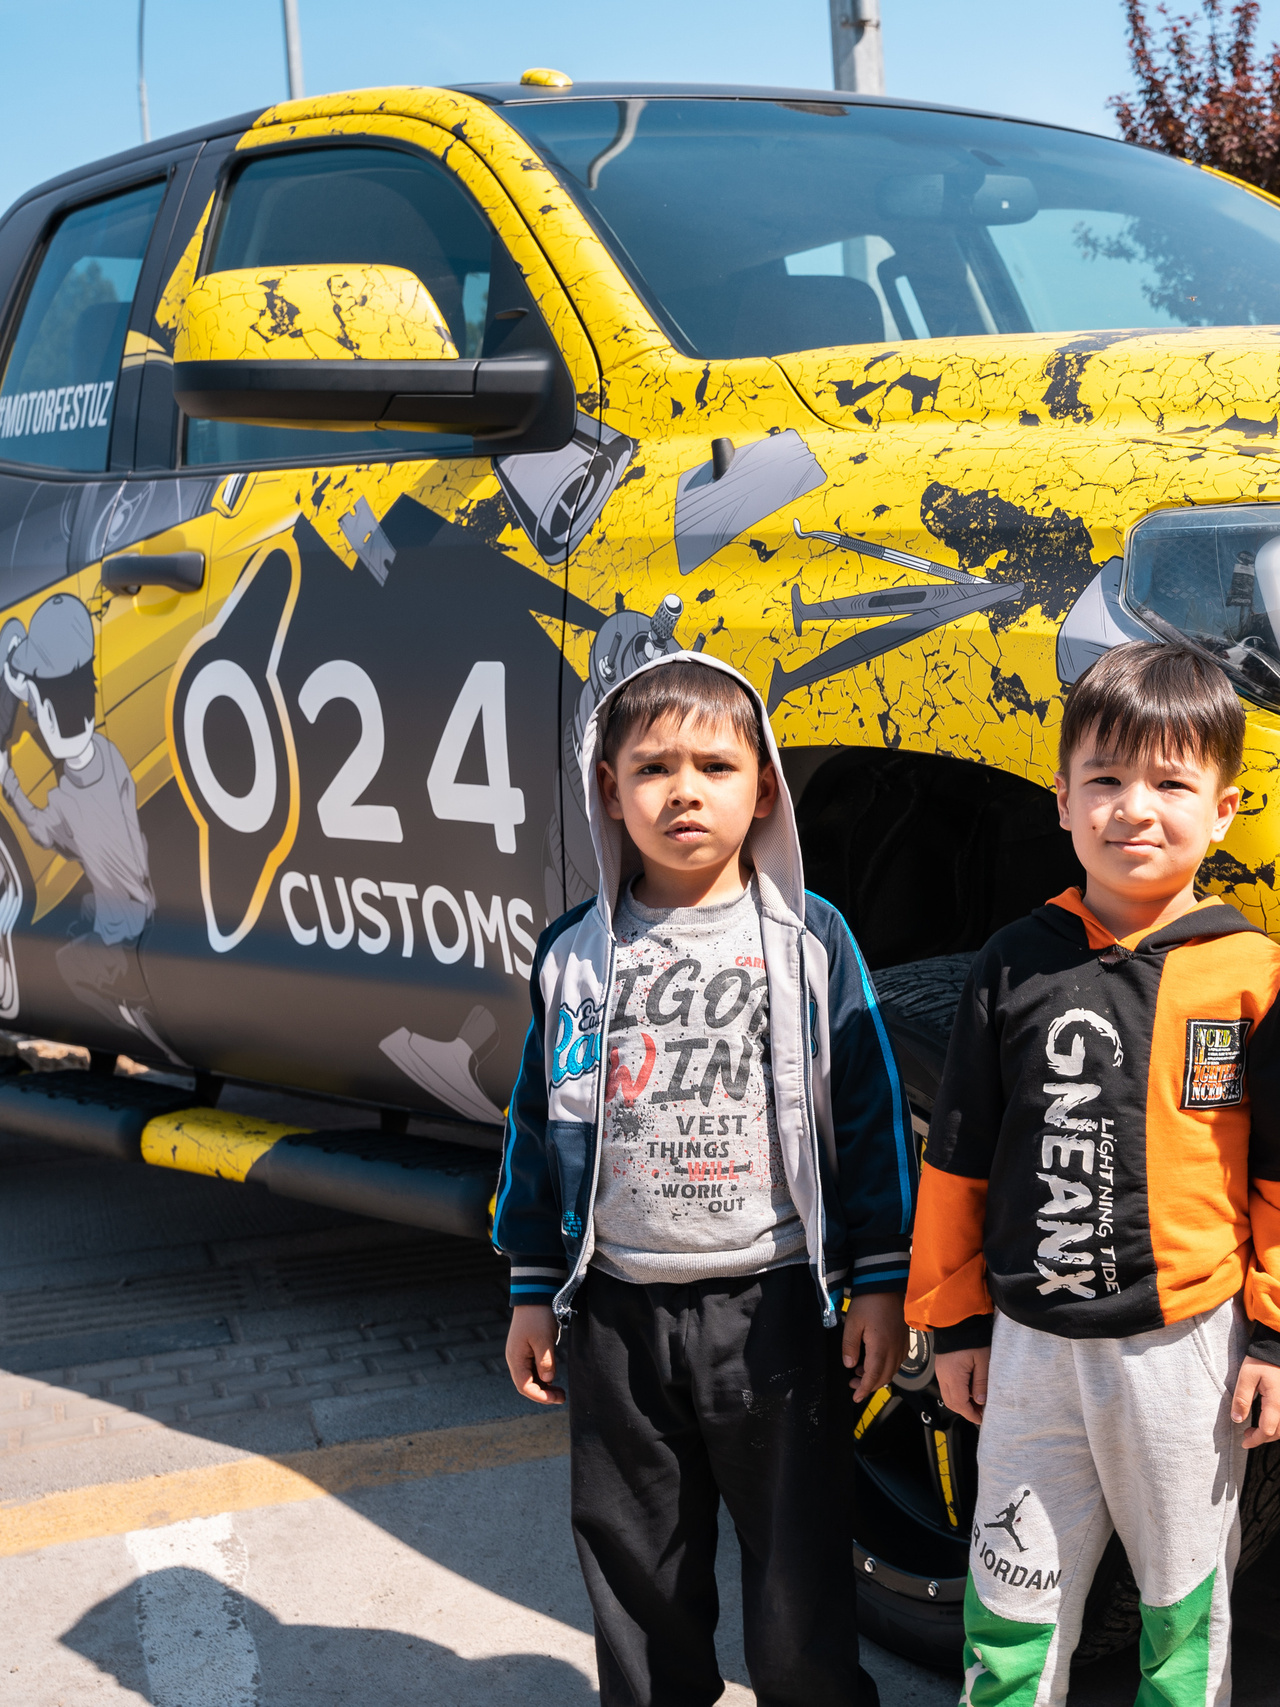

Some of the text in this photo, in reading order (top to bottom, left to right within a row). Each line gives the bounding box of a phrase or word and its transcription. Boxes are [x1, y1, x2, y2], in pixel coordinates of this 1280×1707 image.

[280, 871, 537, 981] CUSTOMS
[676, 1115, 747, 1136] VEST
[647, 1141, 729, 1158] THINGS
[687, 1160, 739, 1182] WILL
[661, 1183, 723, 1198] WORK
[708, 1197, 745, 1213] OUT
[1101, 1245, 1121, 1294] TIDE
[980, 1541, 1062, 1590] JORDAN
